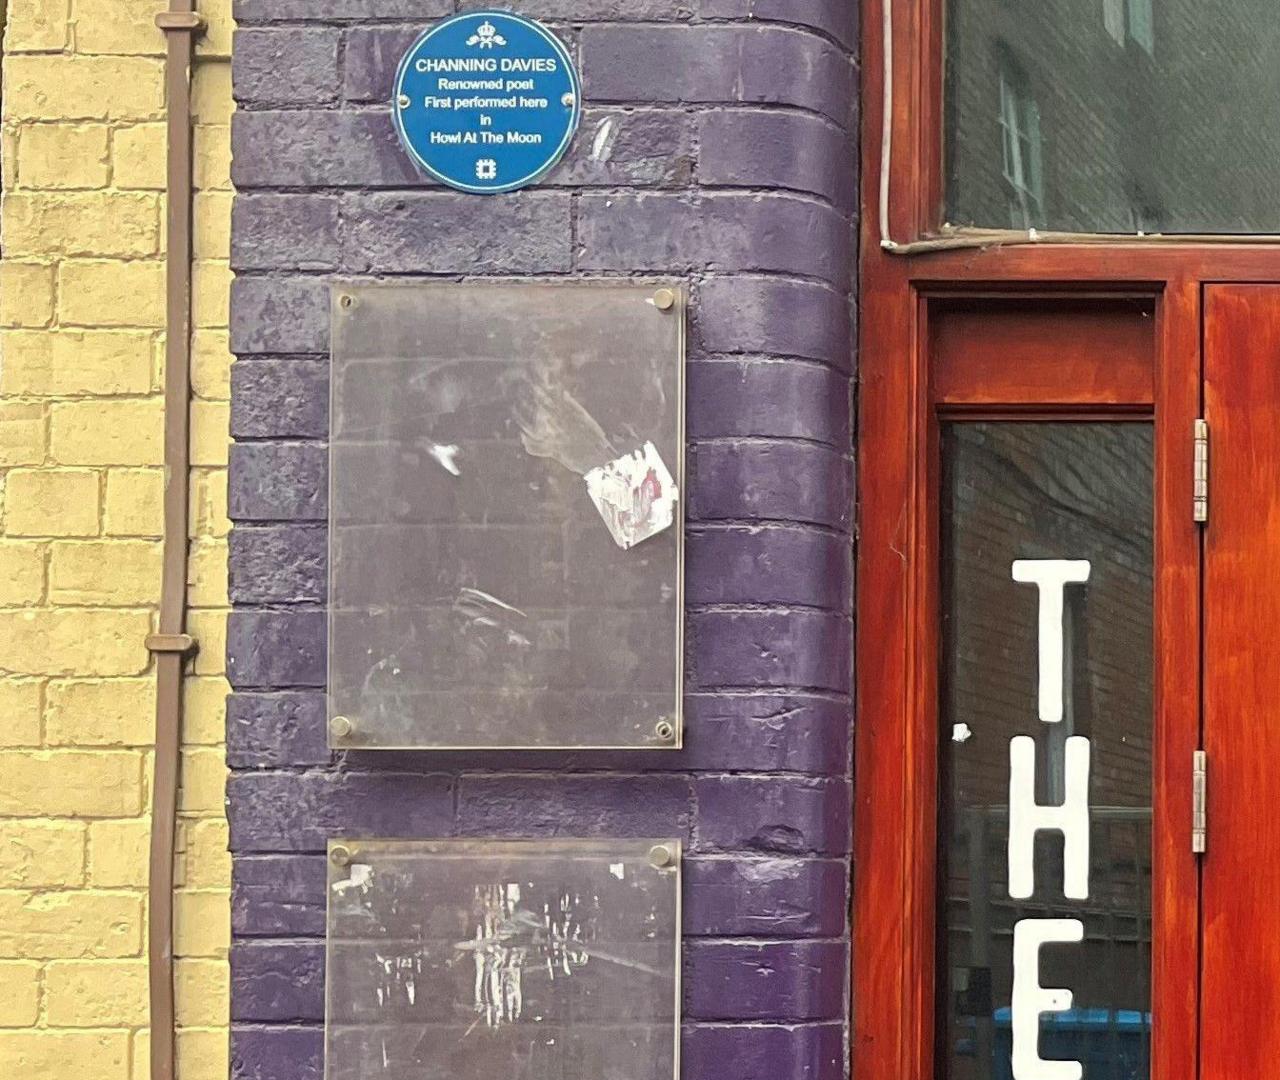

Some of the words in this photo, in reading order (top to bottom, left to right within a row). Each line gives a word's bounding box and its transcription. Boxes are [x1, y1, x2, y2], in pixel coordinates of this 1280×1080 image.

[415, 58, 497, 72] CHANNING
[500, 58, 557, 72] DAVIES
[438, 78, 503, 90] Renowned
[506, 78, 534, 92] poet
[424, 96, 451, 109] First
[454, 95, 516, 110] performed
[519, 95, 548, 108] here
[480, 114, 492, 125] in
[430, 131, 461, 144] Howl
[463, 132, 477, 144] At
[480, 131, 504, 144] The
[507, 131, 542, 144] Moon
